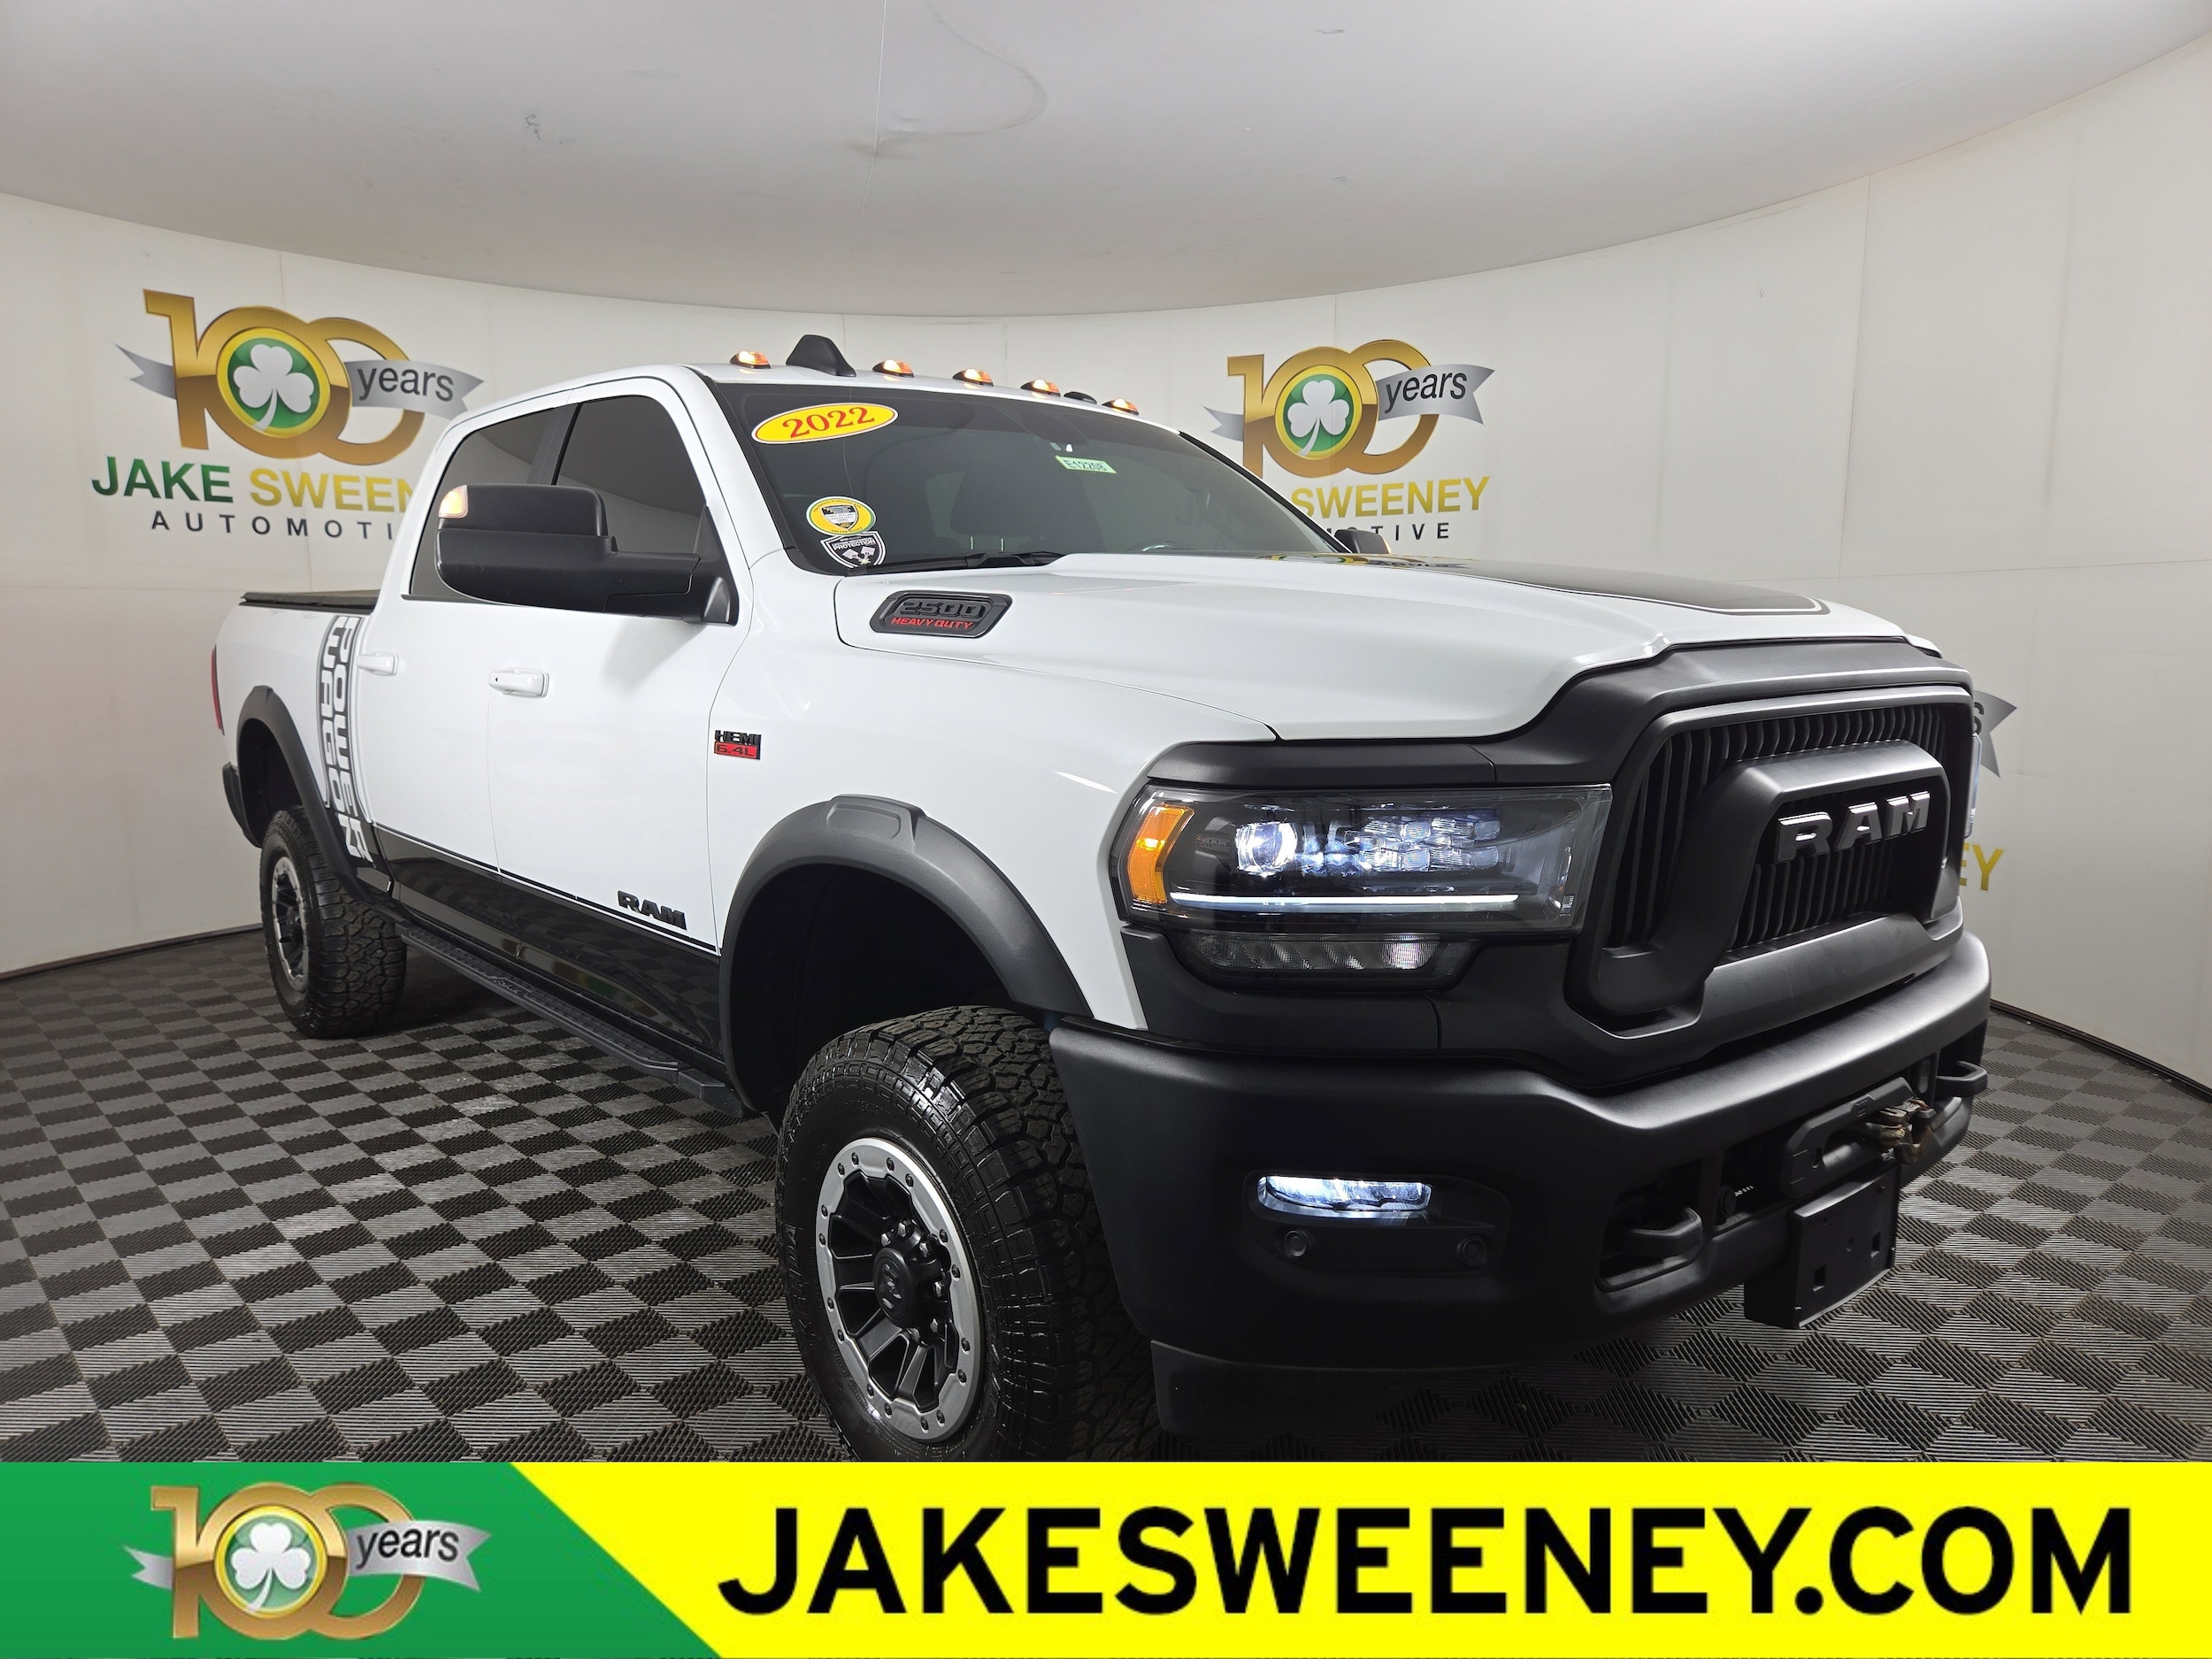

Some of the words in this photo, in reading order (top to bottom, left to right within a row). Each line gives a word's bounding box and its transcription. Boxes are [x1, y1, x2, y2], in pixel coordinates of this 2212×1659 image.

[143, 288, 425, 465] 100
[357, 364, 455, 402] years
[1385, 371, 1468, 414] years
[782, 407, 875, 438] 2022
[1227, 339, 1440, 479] 100
[92, 456, 234, 503] JAKE
[1291, 476, 1491, 518] SWEENEY
[891, 618, 934, 626] HEAVY
[934, 620, 974, 629] DUTY
[900, 601, 984, 618] 2500
[333, 616, 373, 864] POWER
[715, 730, 761, 746] HEMI
[716, 744, 756, 757] 6.4L
[1777, 790, 1930, 864] RAM
[618, 890, 687, 930] RAM
